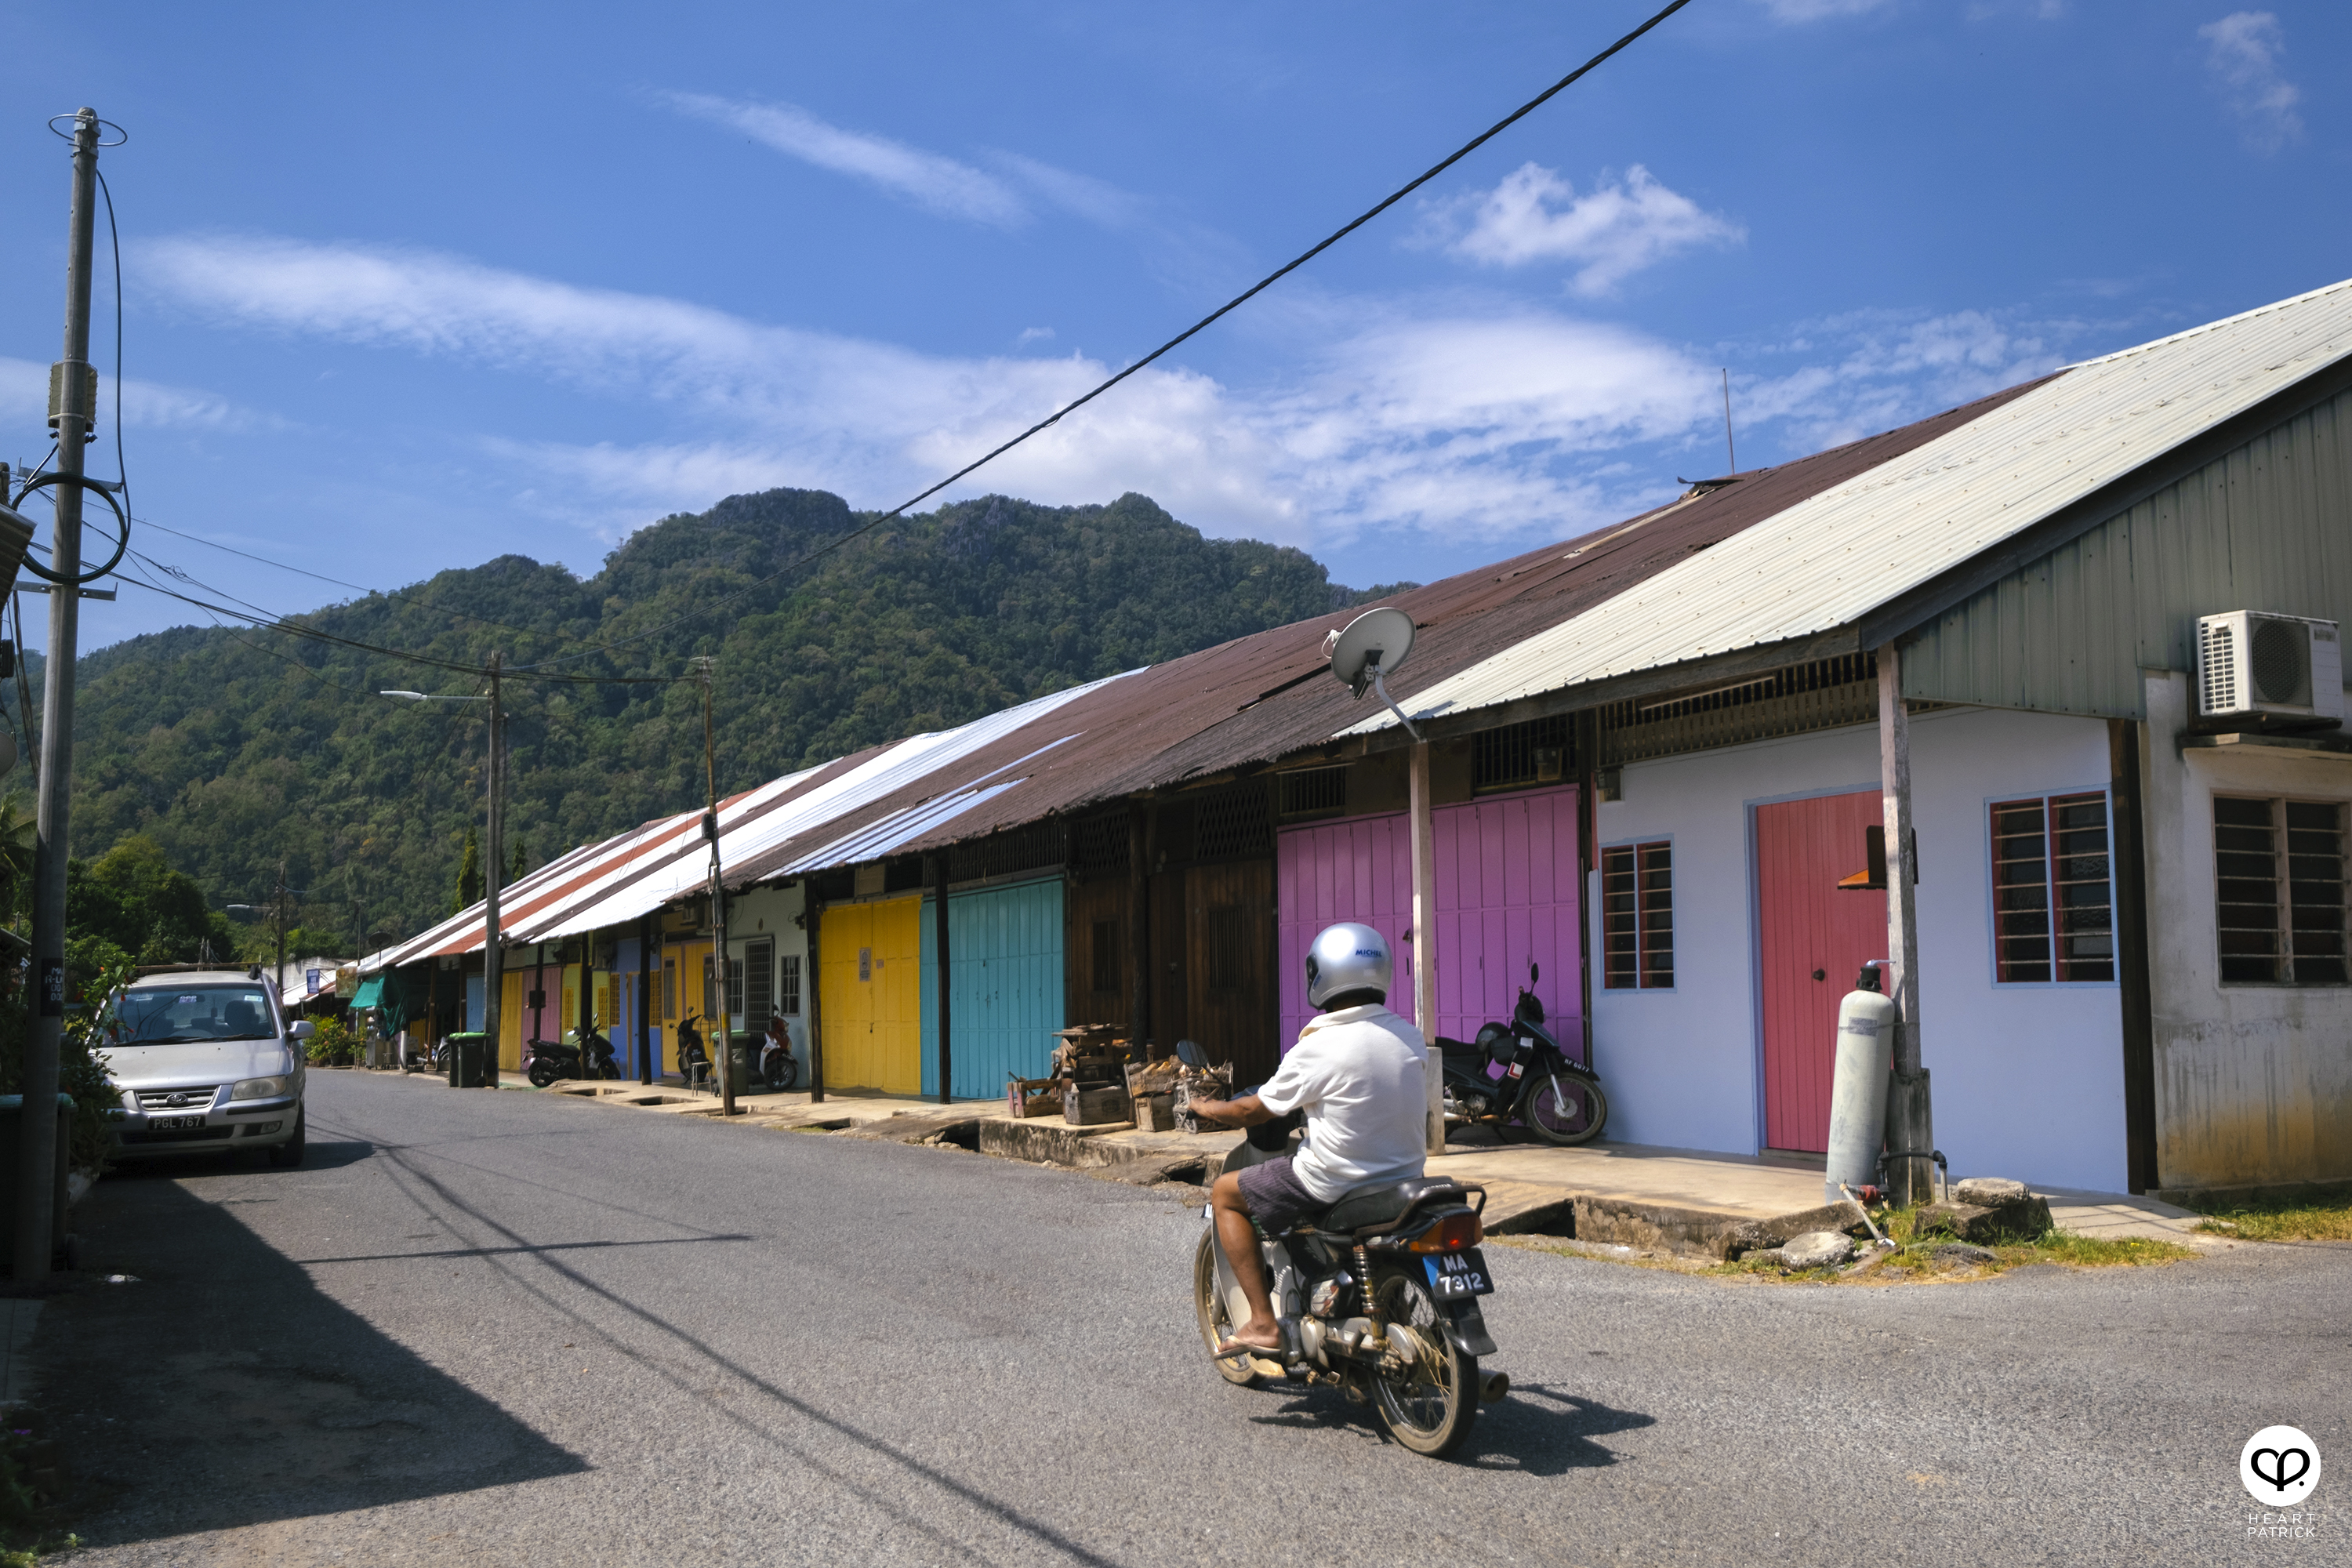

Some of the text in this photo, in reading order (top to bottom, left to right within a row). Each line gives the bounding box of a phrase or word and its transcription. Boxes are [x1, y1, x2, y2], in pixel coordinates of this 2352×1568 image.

[154, 1116, 201, 1129] PGL 767
[1443, 1254, 1468, 1272] MA
[1439, 1272, 1485, 1295] 7312
